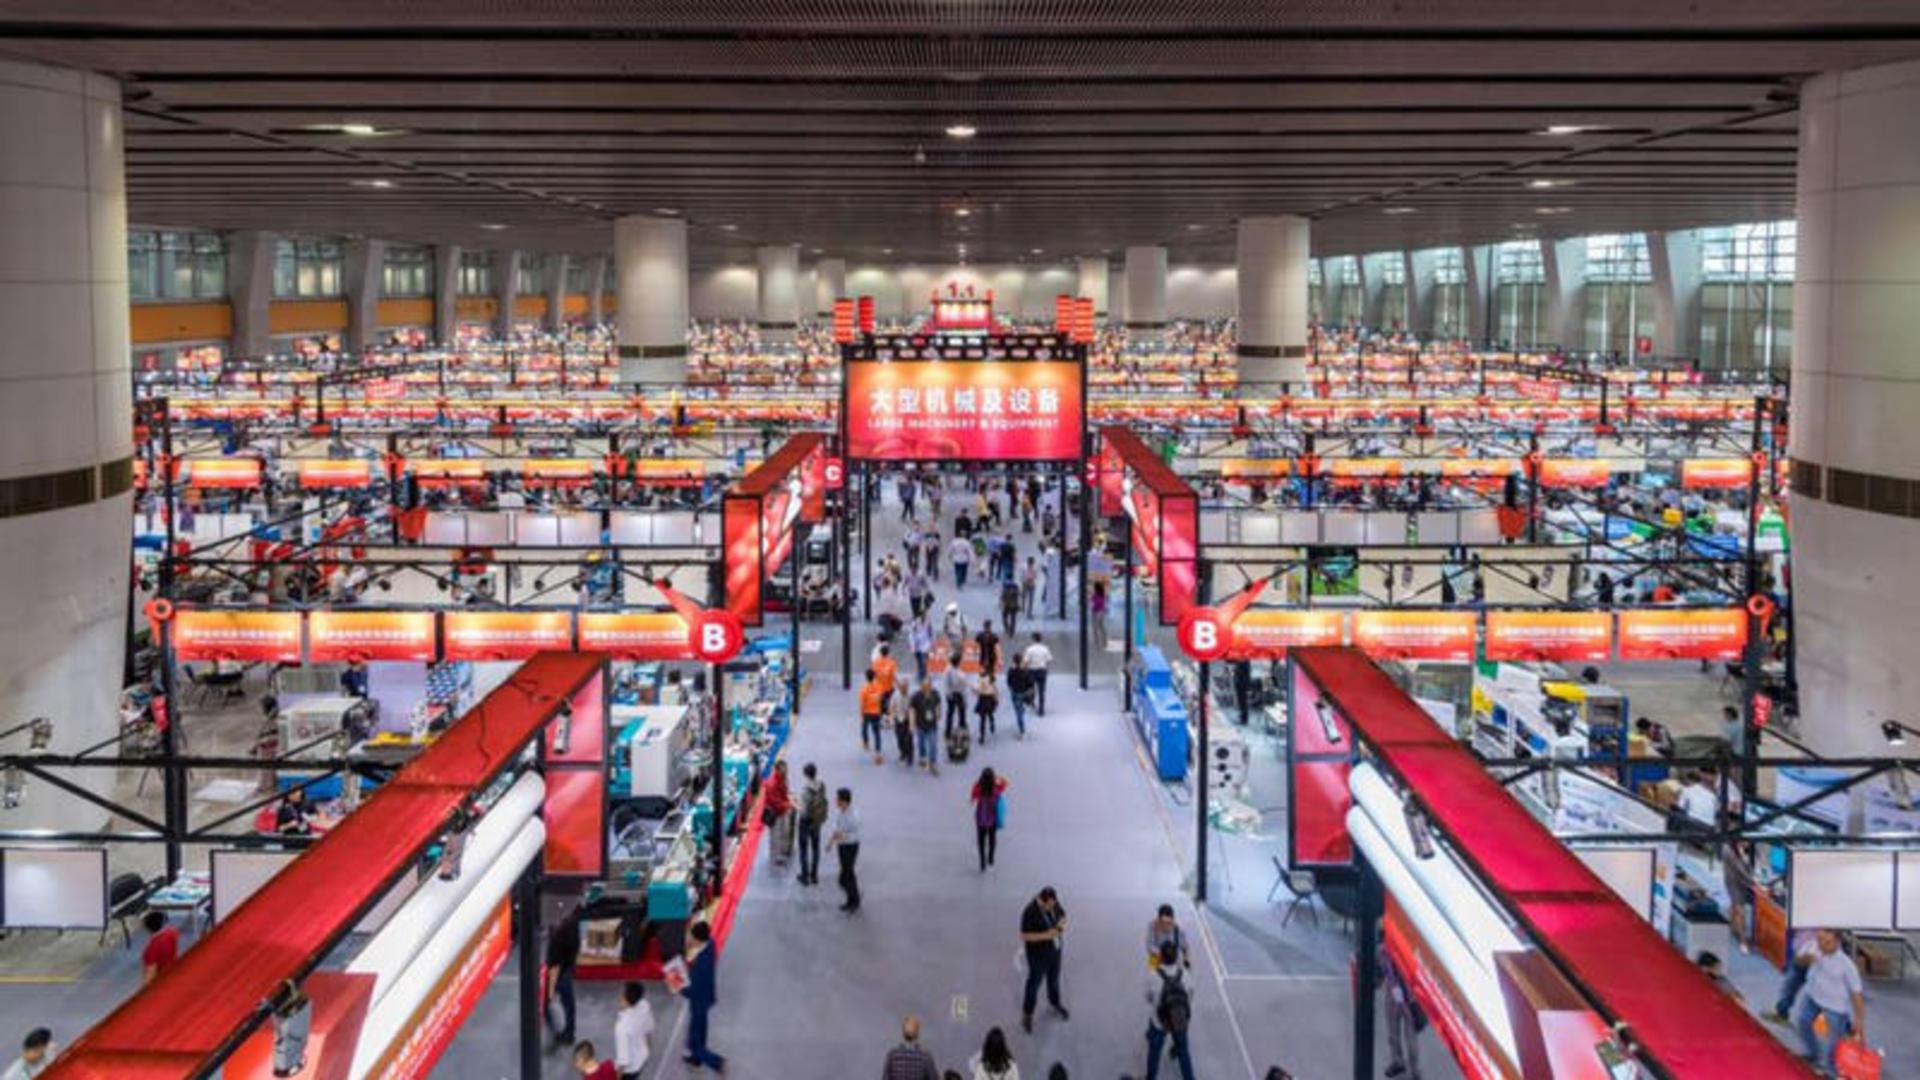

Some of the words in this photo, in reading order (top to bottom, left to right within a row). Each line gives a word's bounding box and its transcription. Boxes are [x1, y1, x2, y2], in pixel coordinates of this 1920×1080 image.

[869, 387, 1059, 414] 大型机械及设备
[825, 465, 841, 481] C
[702, 623, 726, 653] B
[1194, 620, 1218, 651] B
